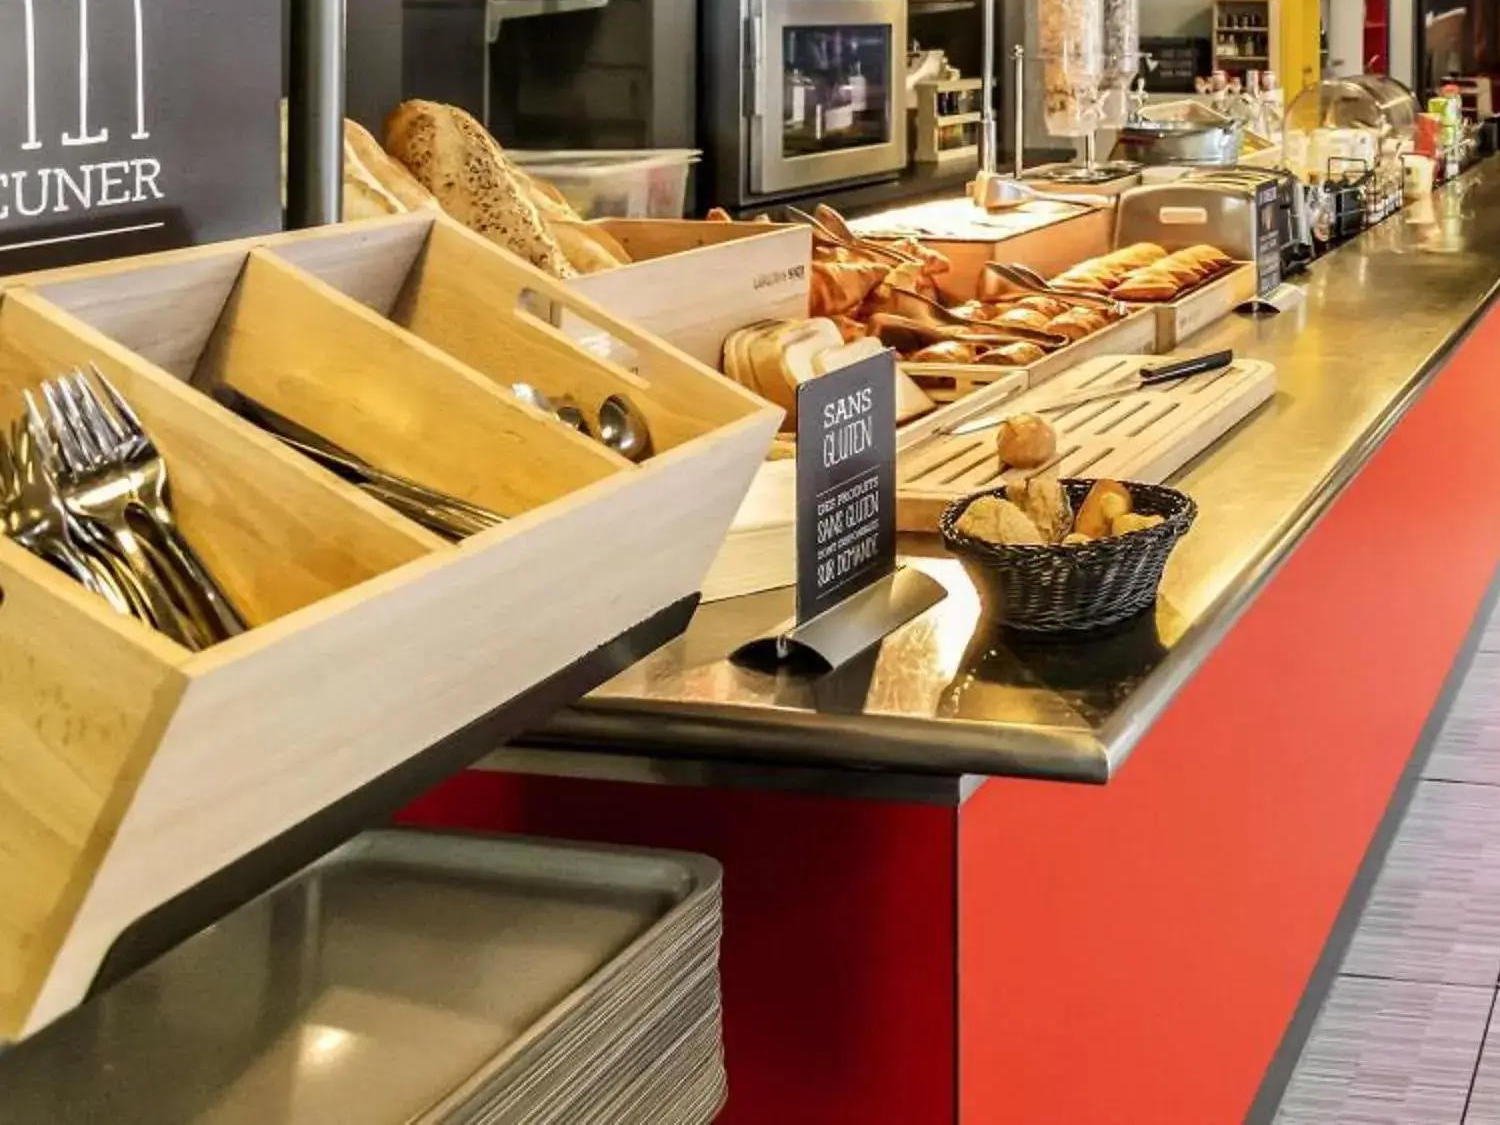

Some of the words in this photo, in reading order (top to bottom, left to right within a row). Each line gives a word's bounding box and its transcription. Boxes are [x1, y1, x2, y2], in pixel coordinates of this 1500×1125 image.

[0, 158, 165, 220] UNER
[823, 386, 872, 429] SANS
[823, 415, 872, 468] GLUTEN
[817, 497, 836, 516] DES
[838, 475, 879, 506] PRODUITS
[817, 510, 844, 544] SANS
[845, 490, 879, 528] GLUTEN
